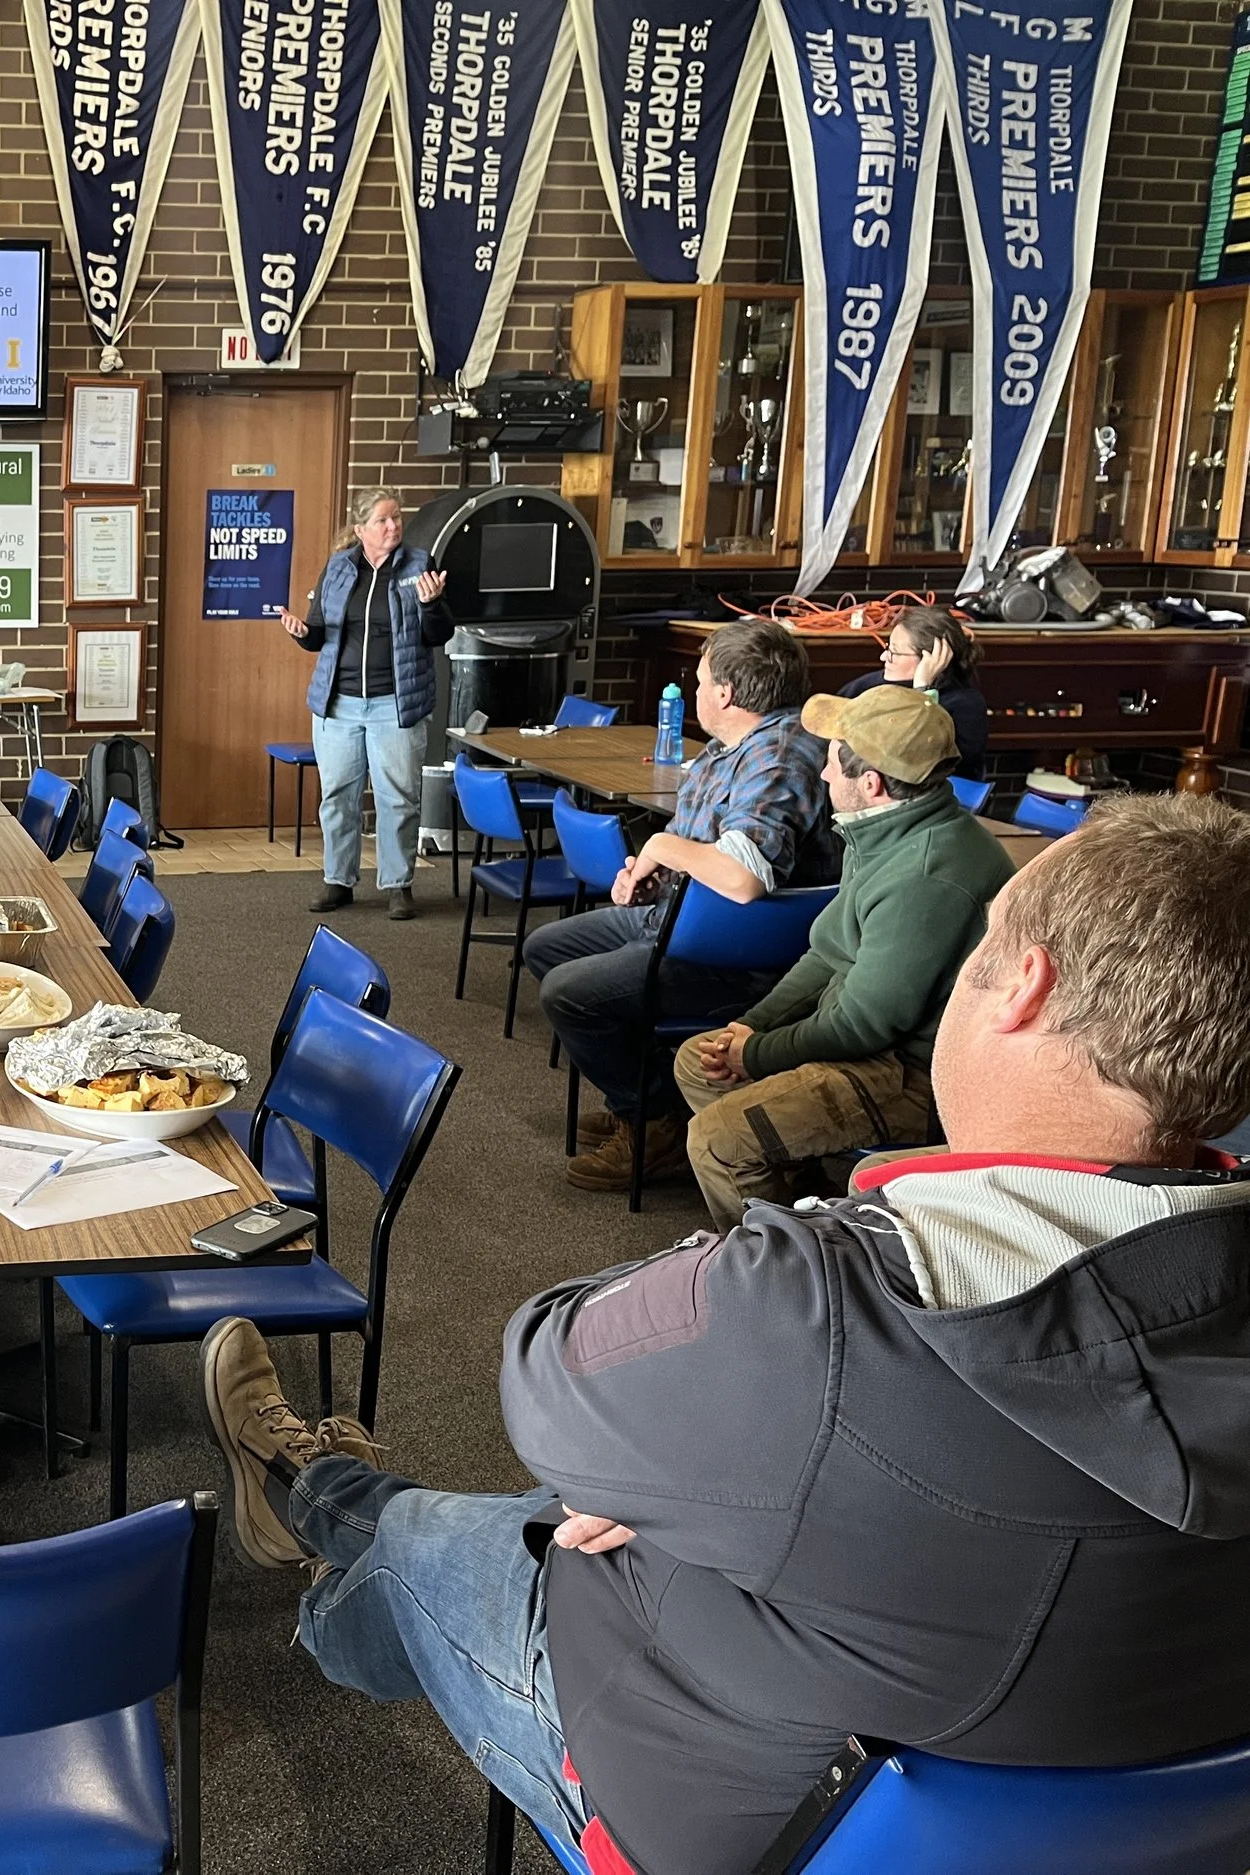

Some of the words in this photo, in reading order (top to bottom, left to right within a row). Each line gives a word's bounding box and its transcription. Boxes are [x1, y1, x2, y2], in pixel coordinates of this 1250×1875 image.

[429, 1, 453, 95] SECONDS
[953, 0, 984, 19] L
[990, 11, 1021, 35] F
[1025, 17, 1058, 40] G
[1062, 16, 1093, 42] M
[113, 0, 150, 157] ORPDALE
[487, 55, 511, 137] GOLDEN
[624, 17, 649, 93] SENIOR
[805, 28, 842, 117] THIRDS
[443, 11, 491, 205] THORPDALE
[641, 23, 686, 211] THORPDALE
[680, 61, 705, 141] GOLDEN
[894, 40, 920, 171] THORPDALE
[967, 52, 991, 146] THIRDS
[1049, 65, 1074, 194] THORPDALE
[418, 103, 444, 210] PREMIERS
[621, 100, 641, 200] PREMIERS
[846, 34, 897, 248] PREMIERS
[1001, 60, 1043, 270] PREMIERS
[111, 180, 136, 248] F.C.
[302, 186, 330, 235] F.C
[477, 146, 501, 232] JUBILEE
[678, 150, 697, 230] JUBILEE
[87, 251, 118, 337] 1967
[260, 253, 296, 335] 1976
[227, 336, 248, 361] NO
[834, 283, 883, 390] 1987
[1000, 294, 1048, 407] 2009
[3, 386, 31, 396] Idaho
[210, 528, 239, 543] NOT
[241, 528, 287, 544] SPEED
[211, 495, 258, 511] BREAK
[211, 512, 271, 527] TACKLES
[209, 544, 258, 560] LIMITS
